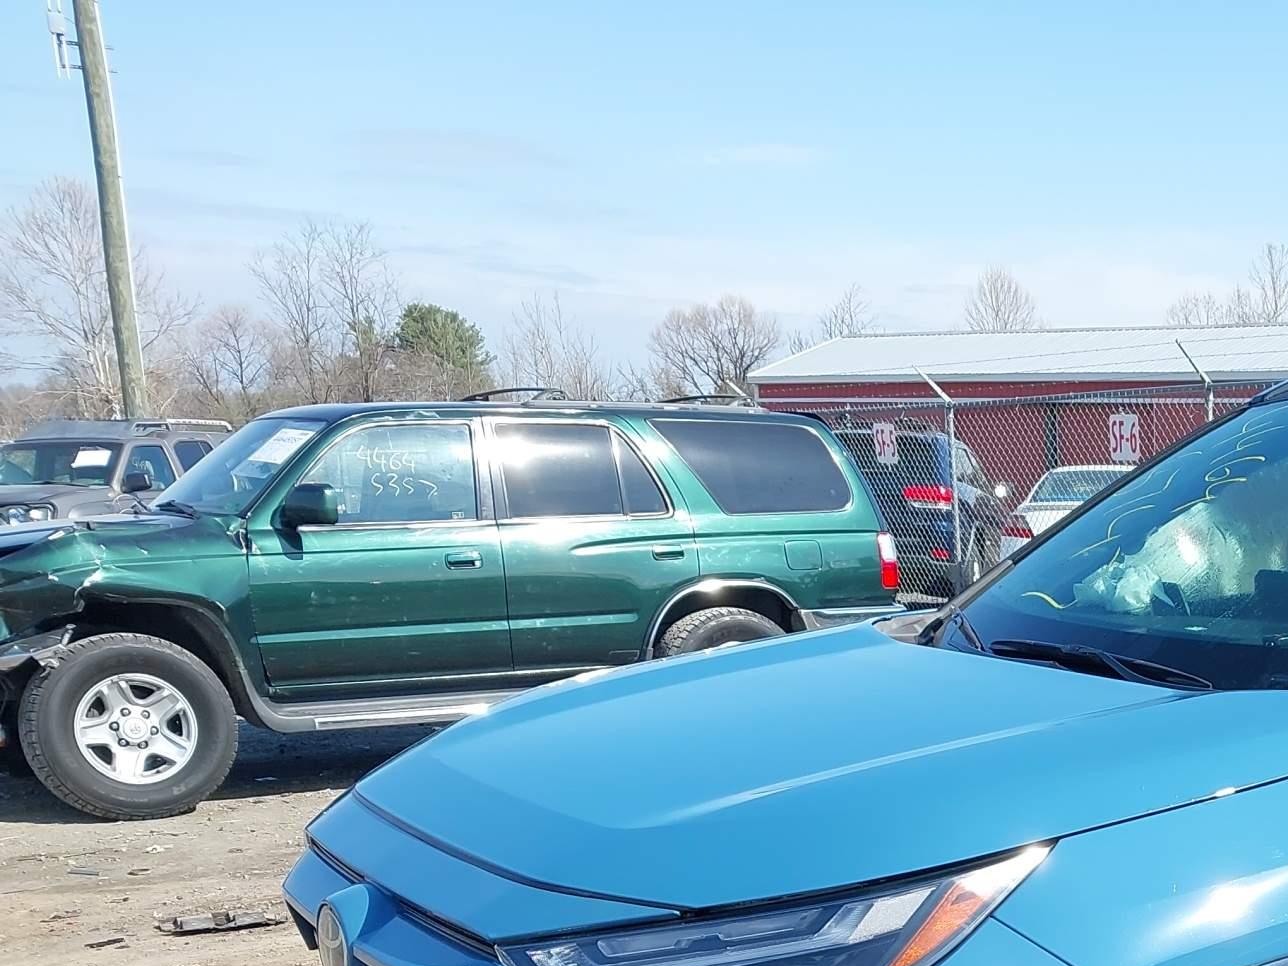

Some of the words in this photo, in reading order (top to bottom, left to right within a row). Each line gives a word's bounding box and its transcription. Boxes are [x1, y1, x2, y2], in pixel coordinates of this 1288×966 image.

[875, 428, 896, 458] SF-5
[1111, 420, 1138, 454] SF-6
[356, 444, 416, 474] 4464
